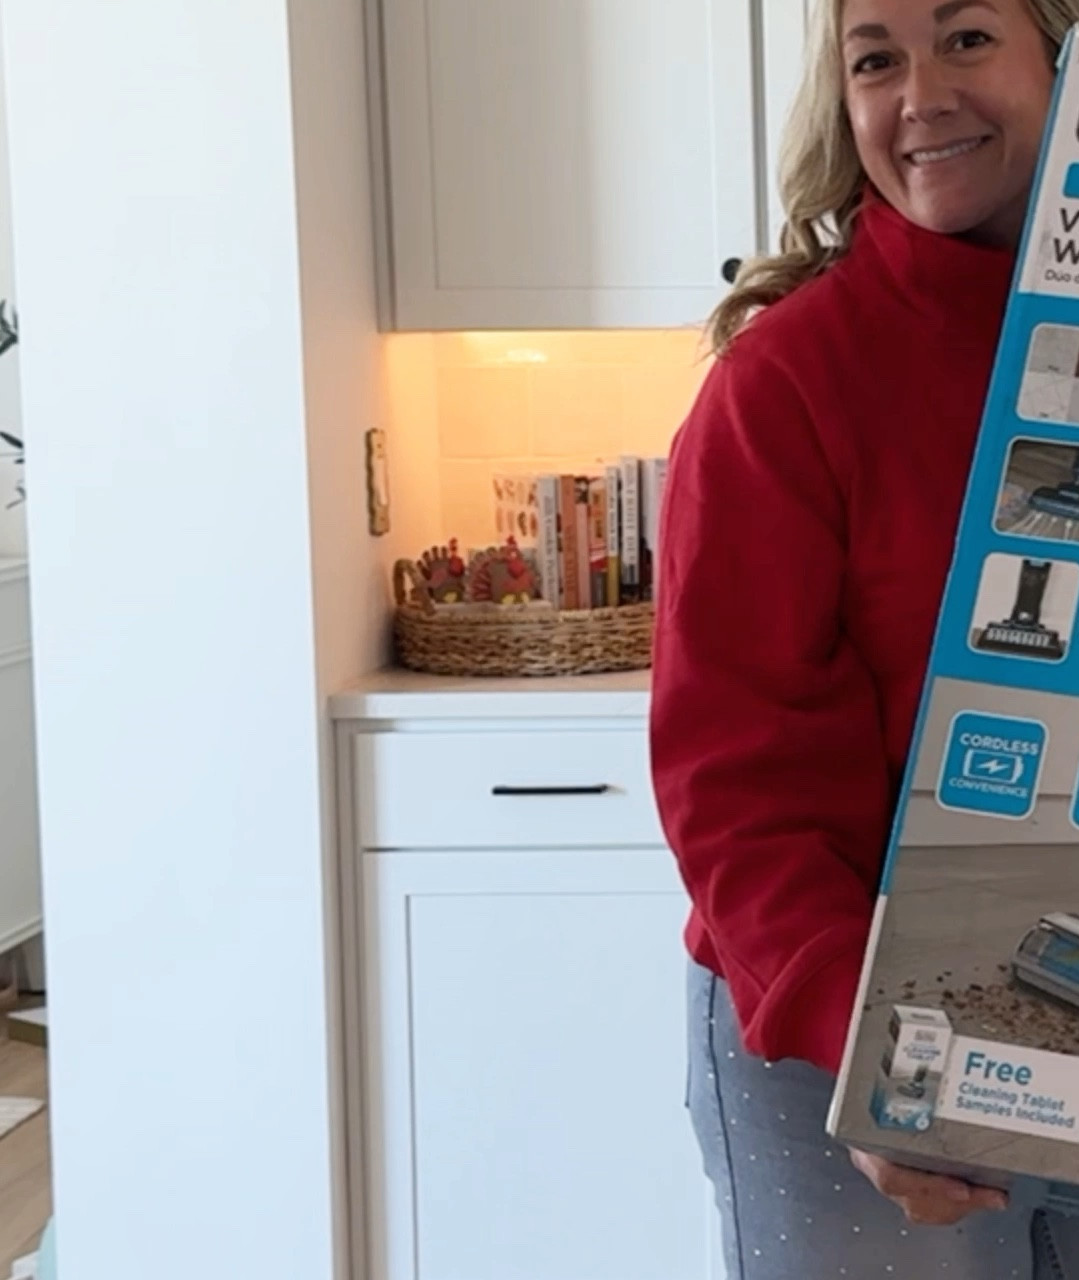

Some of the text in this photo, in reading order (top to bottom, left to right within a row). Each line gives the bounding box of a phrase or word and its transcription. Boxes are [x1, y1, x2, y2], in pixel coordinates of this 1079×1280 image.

[959, 732, 1040, 756] CORDLESS
[949, 777, 1030, 798] CONVENIENCE
[964, 1051, 1033, 1086] Free
[958, 1081, 1066, 1112] Cleaning Tablet
[956, 1096, 1076, 1129] Samples Included
